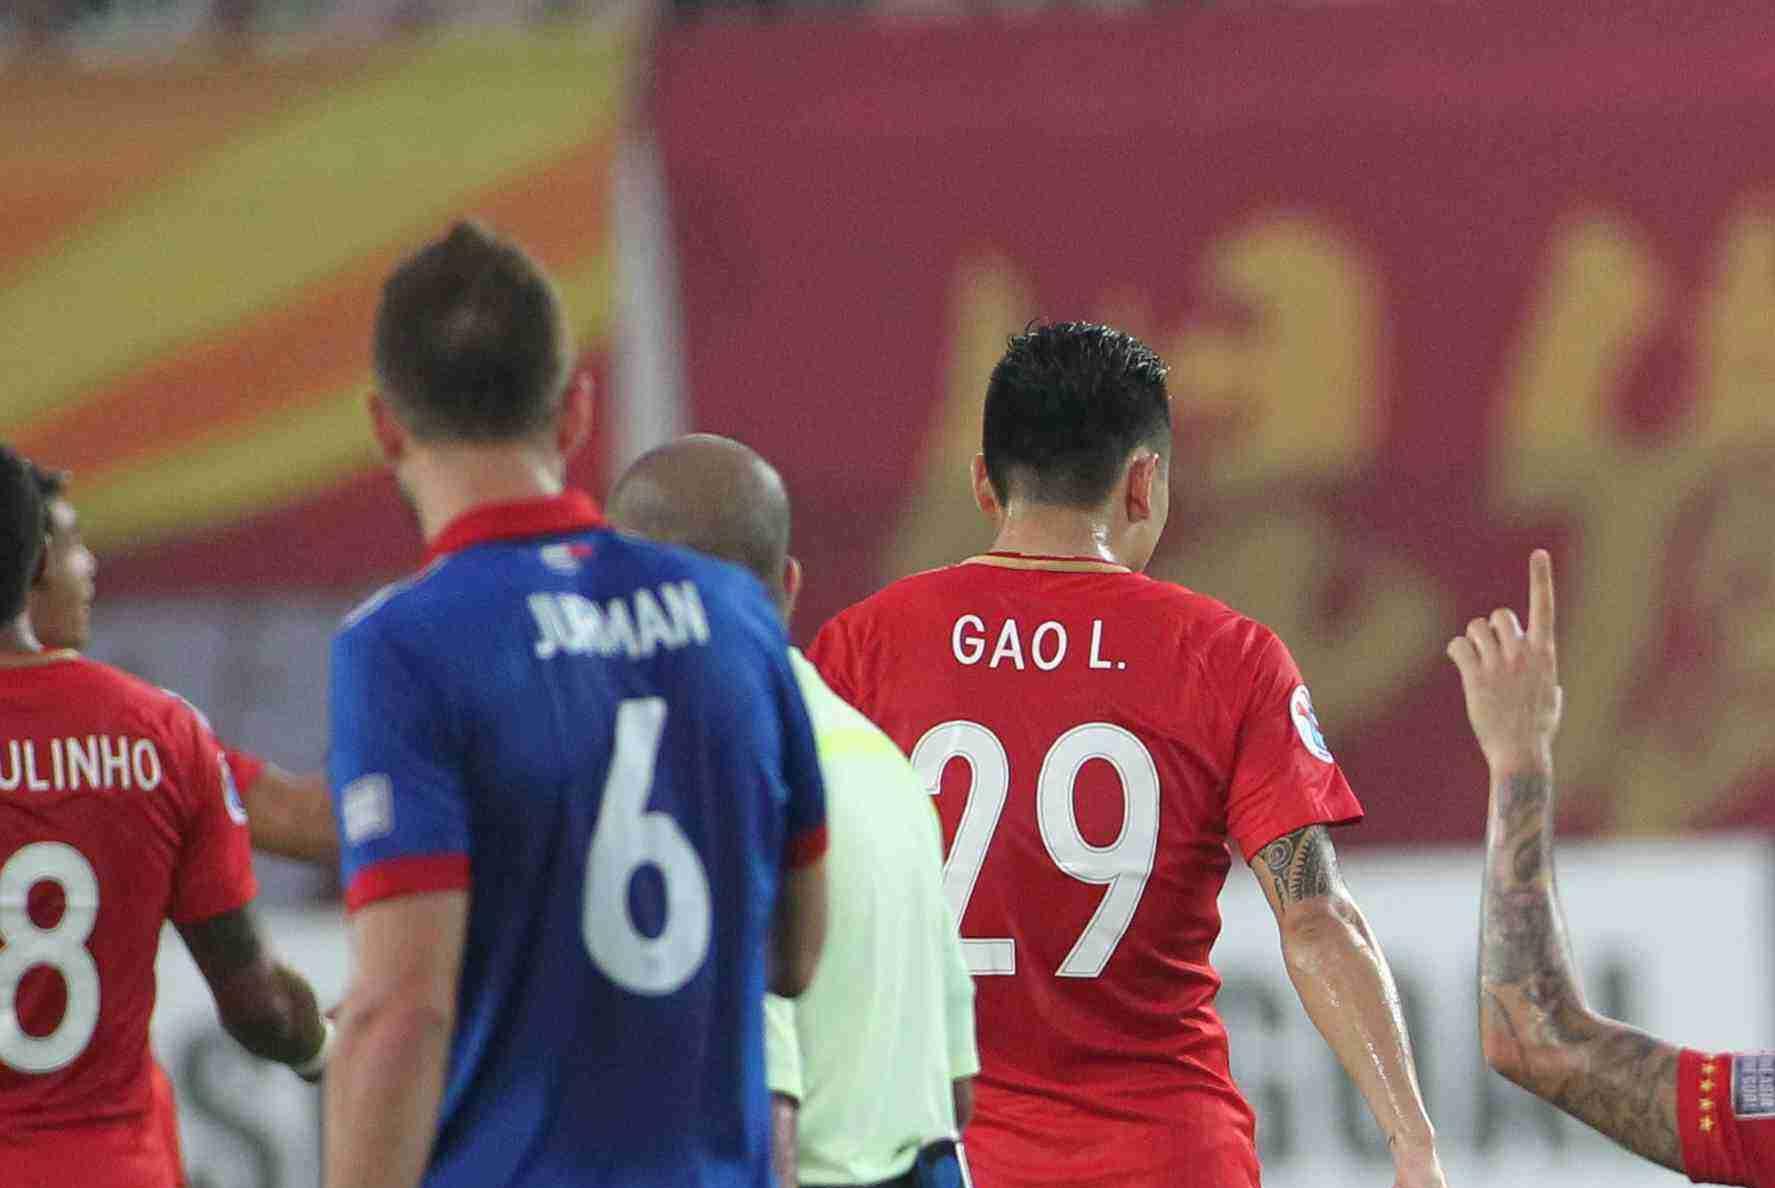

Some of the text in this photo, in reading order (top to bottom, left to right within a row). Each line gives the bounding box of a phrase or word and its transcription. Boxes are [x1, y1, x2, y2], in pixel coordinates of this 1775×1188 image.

[951, 614, 1127, 671] GAO L.
[0, 840, 100, 1074] 8
[581, 696, 712, 996] 6
[910, 719, 1161, 978] 29
